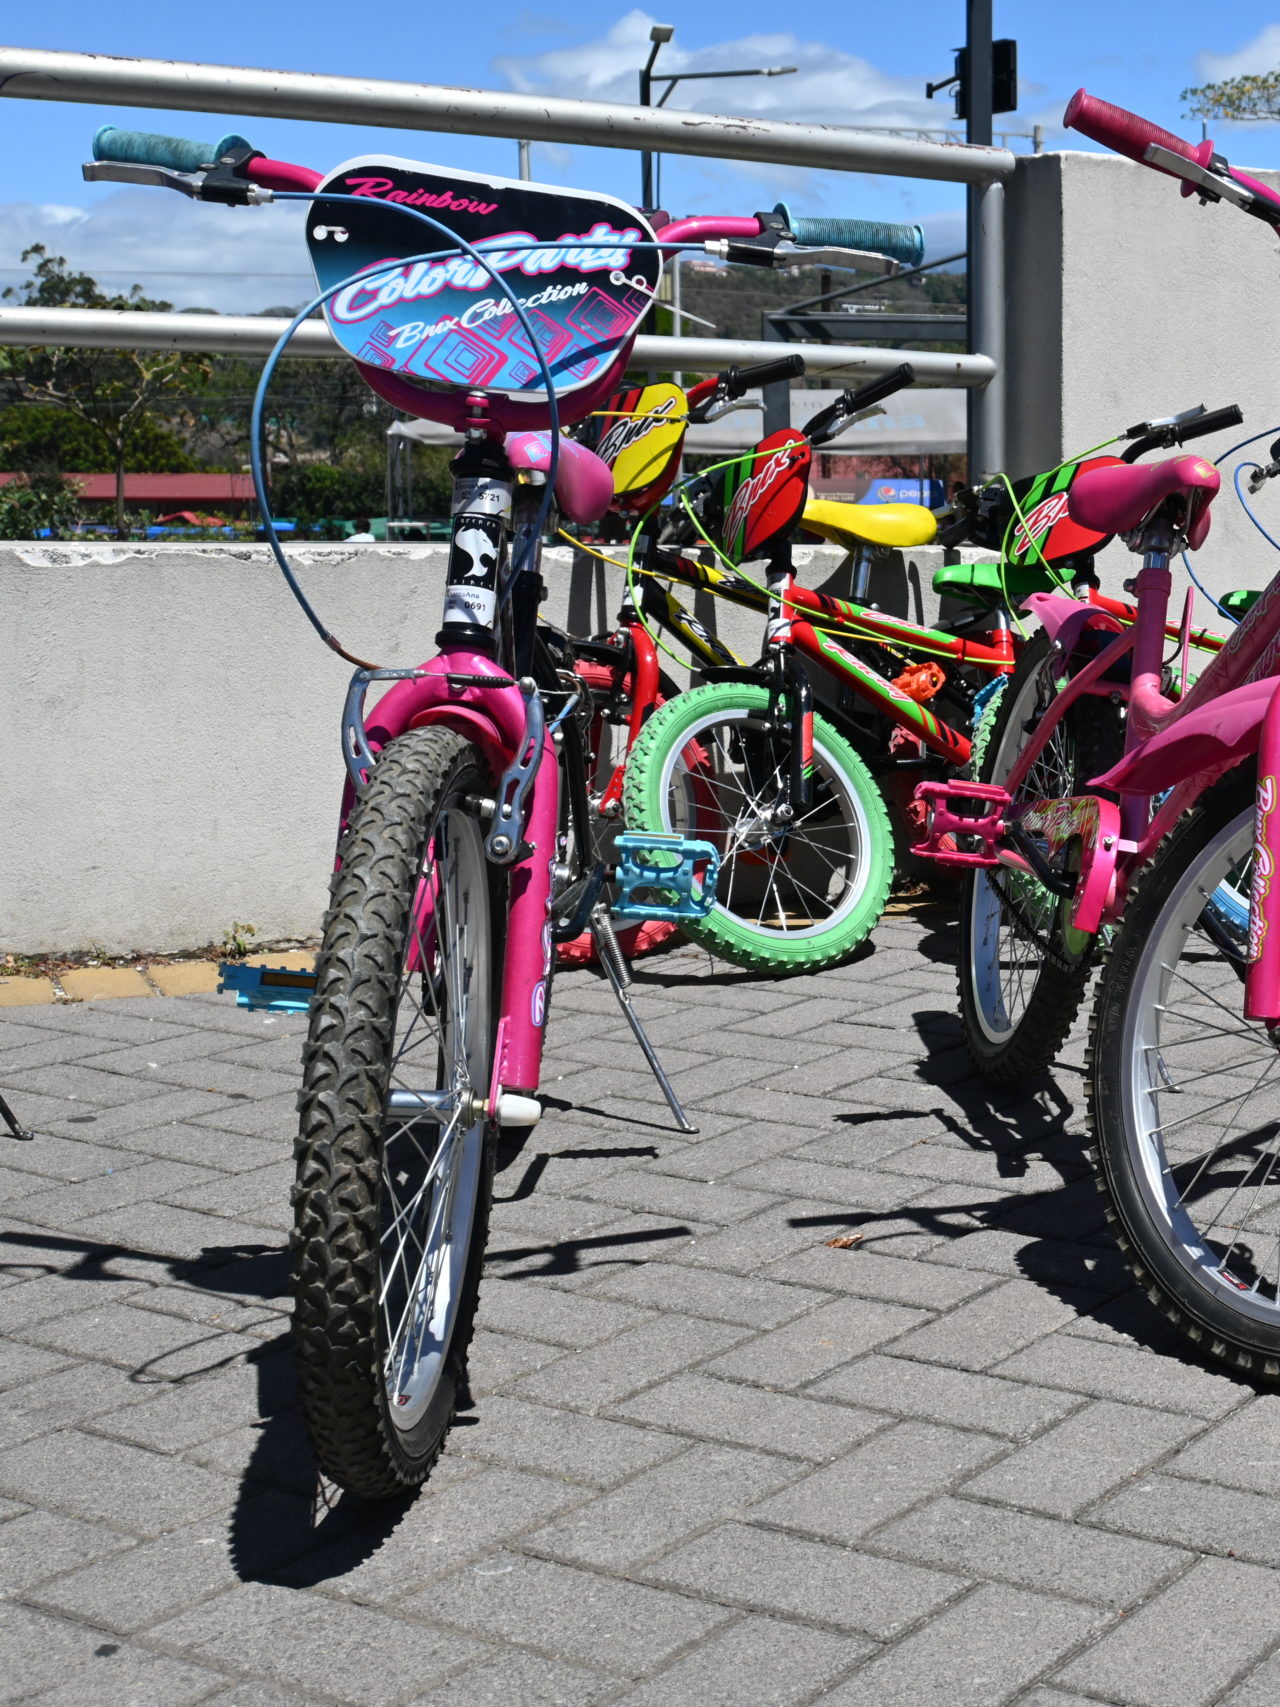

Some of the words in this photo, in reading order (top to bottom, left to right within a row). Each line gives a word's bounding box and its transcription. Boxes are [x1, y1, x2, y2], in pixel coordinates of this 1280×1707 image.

[345, 176, 499, 216] Rainbow
[388, 319, 459, 349] Bmx
[459, 281, 590, 327] Collection
[596, 397, 676, 464] Bmx
[722, 439, 797, 556] Bmx
[824, 637, 914, 703] Racing
